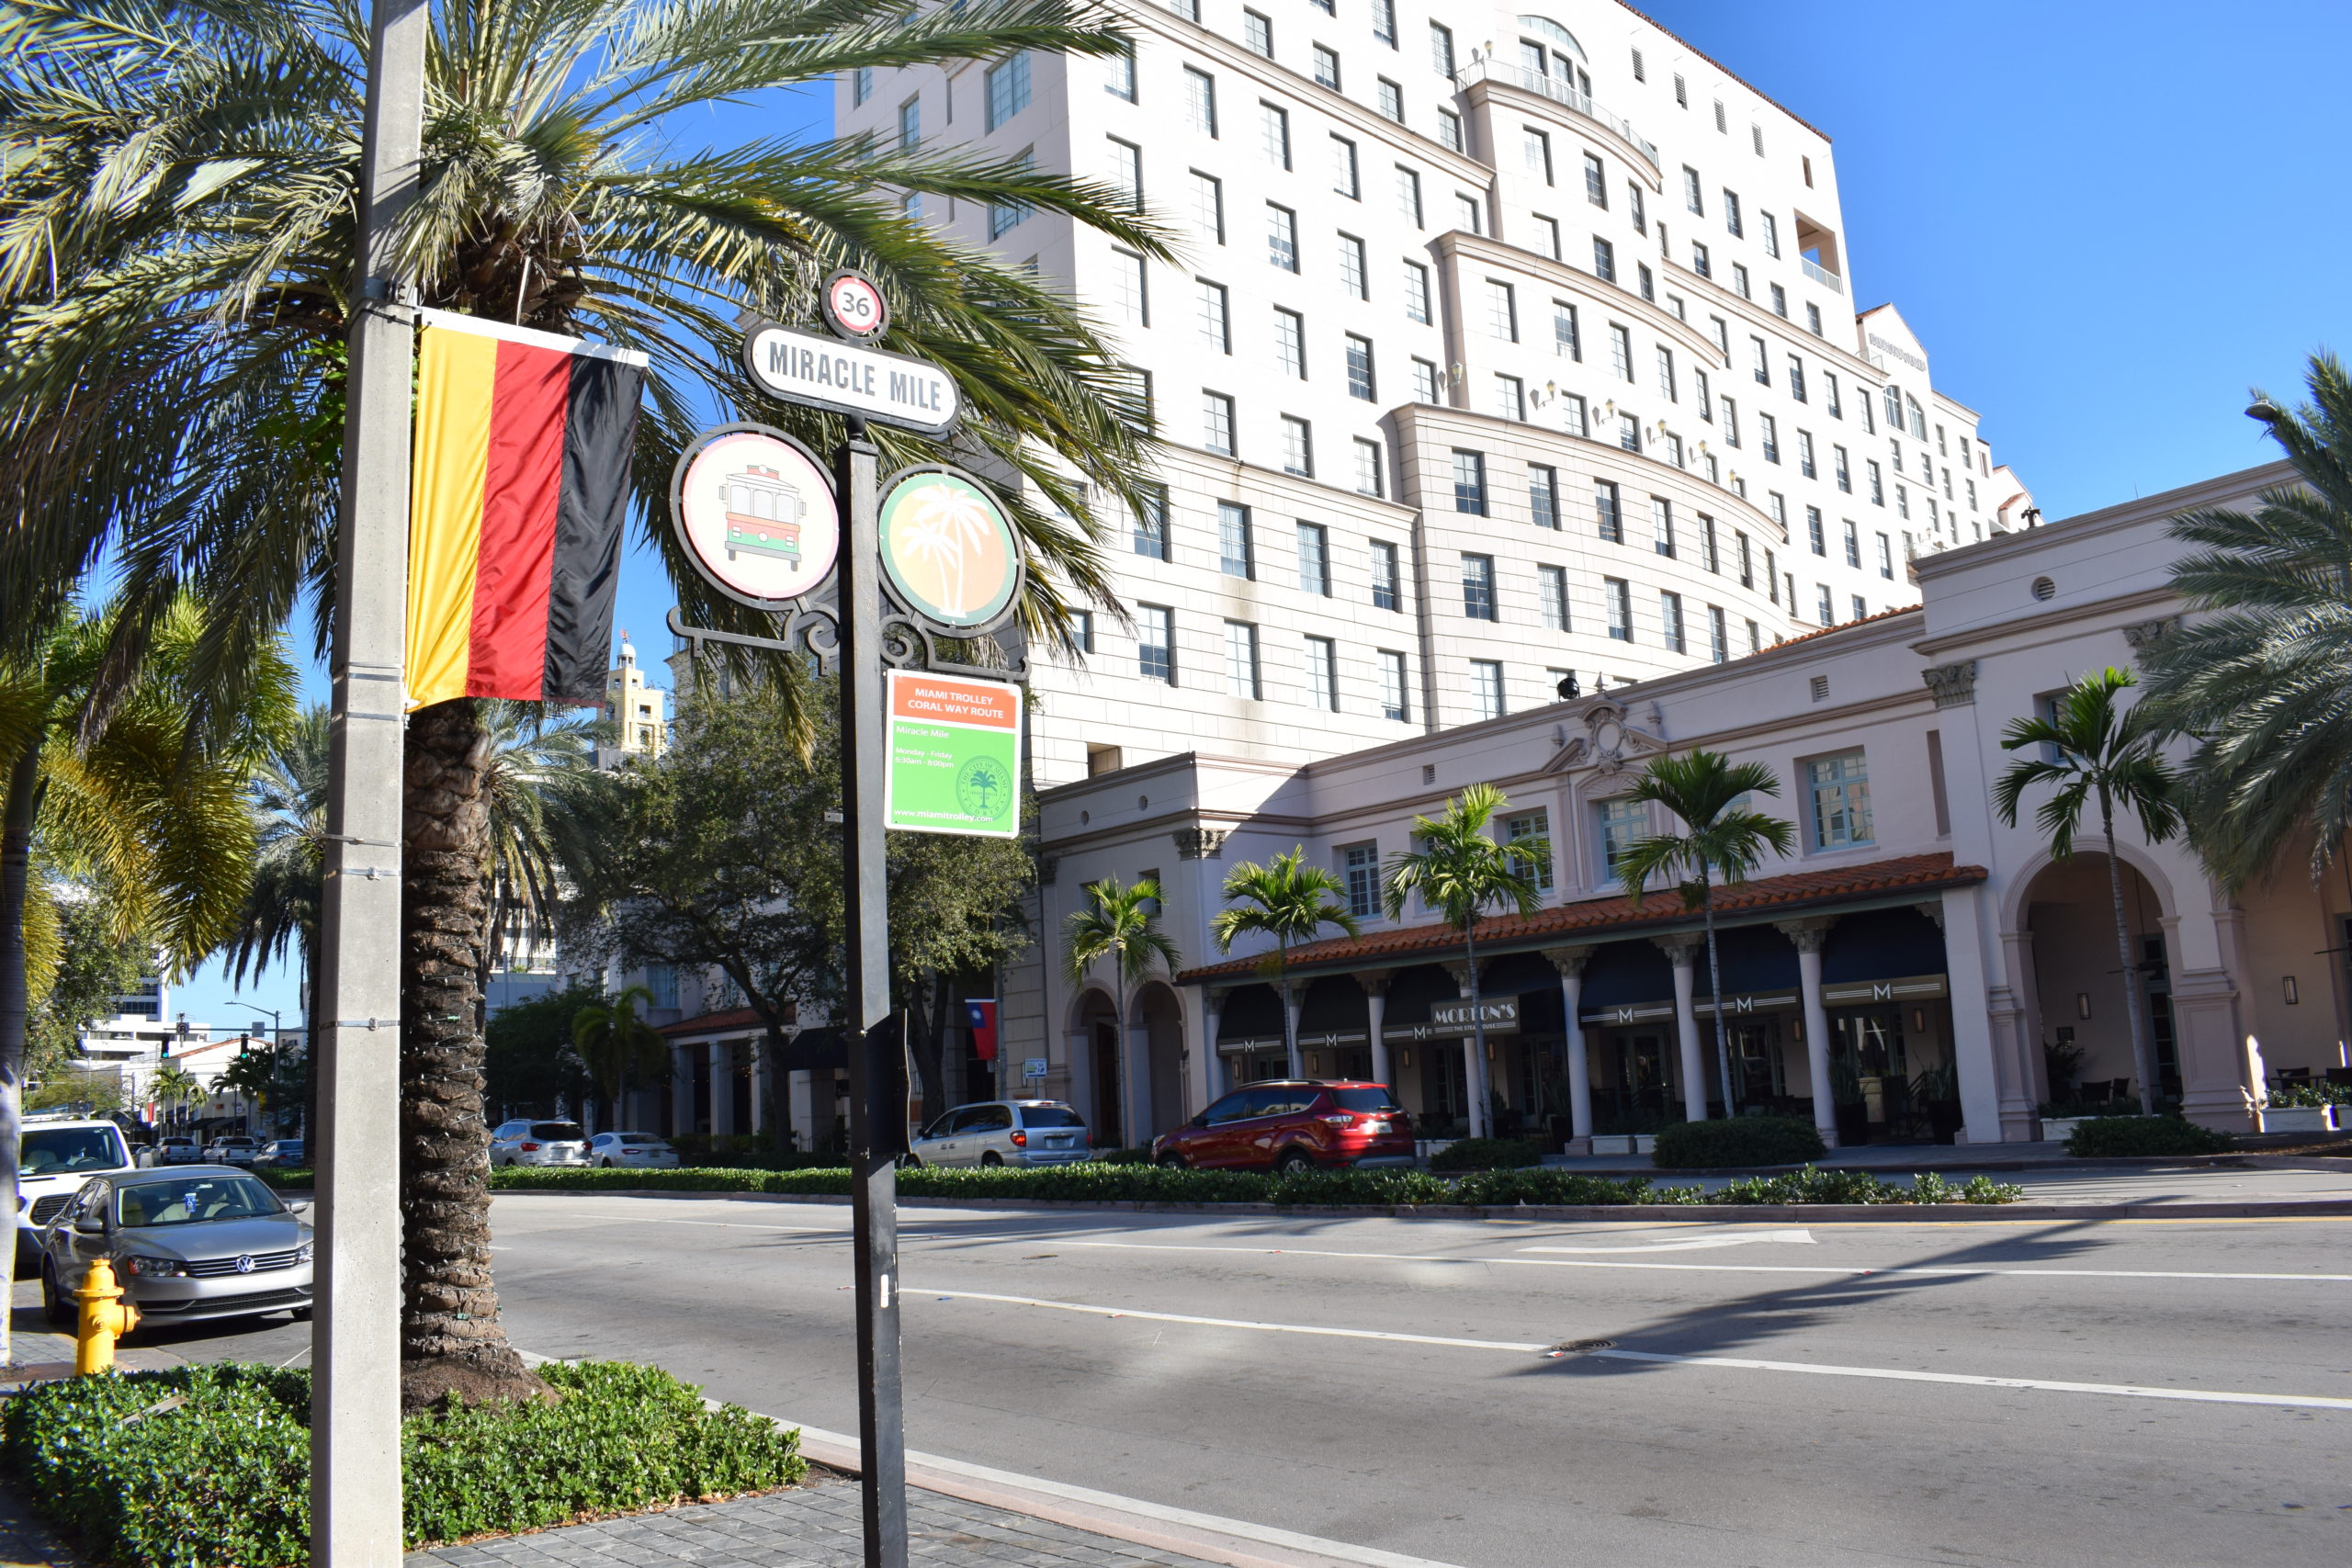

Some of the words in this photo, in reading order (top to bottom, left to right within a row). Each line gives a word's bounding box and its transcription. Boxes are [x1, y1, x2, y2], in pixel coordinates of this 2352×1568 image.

[842, 292, 871, 318] 36
[769, 341, 876, 397] MIRACLE
[889, 370, 941, 412] MILE
[915, 688, 948, 700] MIAMI
[949, 692, 993, 705] TROLLEY
[908, 699, 943, 712] CORAL
[944, 704, 969, 715] WAY
[970, 706, 1004, 719] ROUTE
[896, 726, 929, 737] Miracle
[930, 728, 950, 739] Mile
[896, 747, 925, 757] Monday
[931, 750, 953, 760] Friday
[894, 809, 993, 823] www.miamitrolley.com
[1873, 983, 1891, 1000] M
[1736, 996, 1752, 1012] M
[1434, 1003, 1516, 1023] MORTON'S
[1619, 1008, 1633, 1023] M
[1414, 1026, 1426, 1040] M
[1464, 1023, 1496, 1032] STEAOUSE
[1244, 1039, 1255, 1053] M
[1326, 1033, 1338, 1047] M
